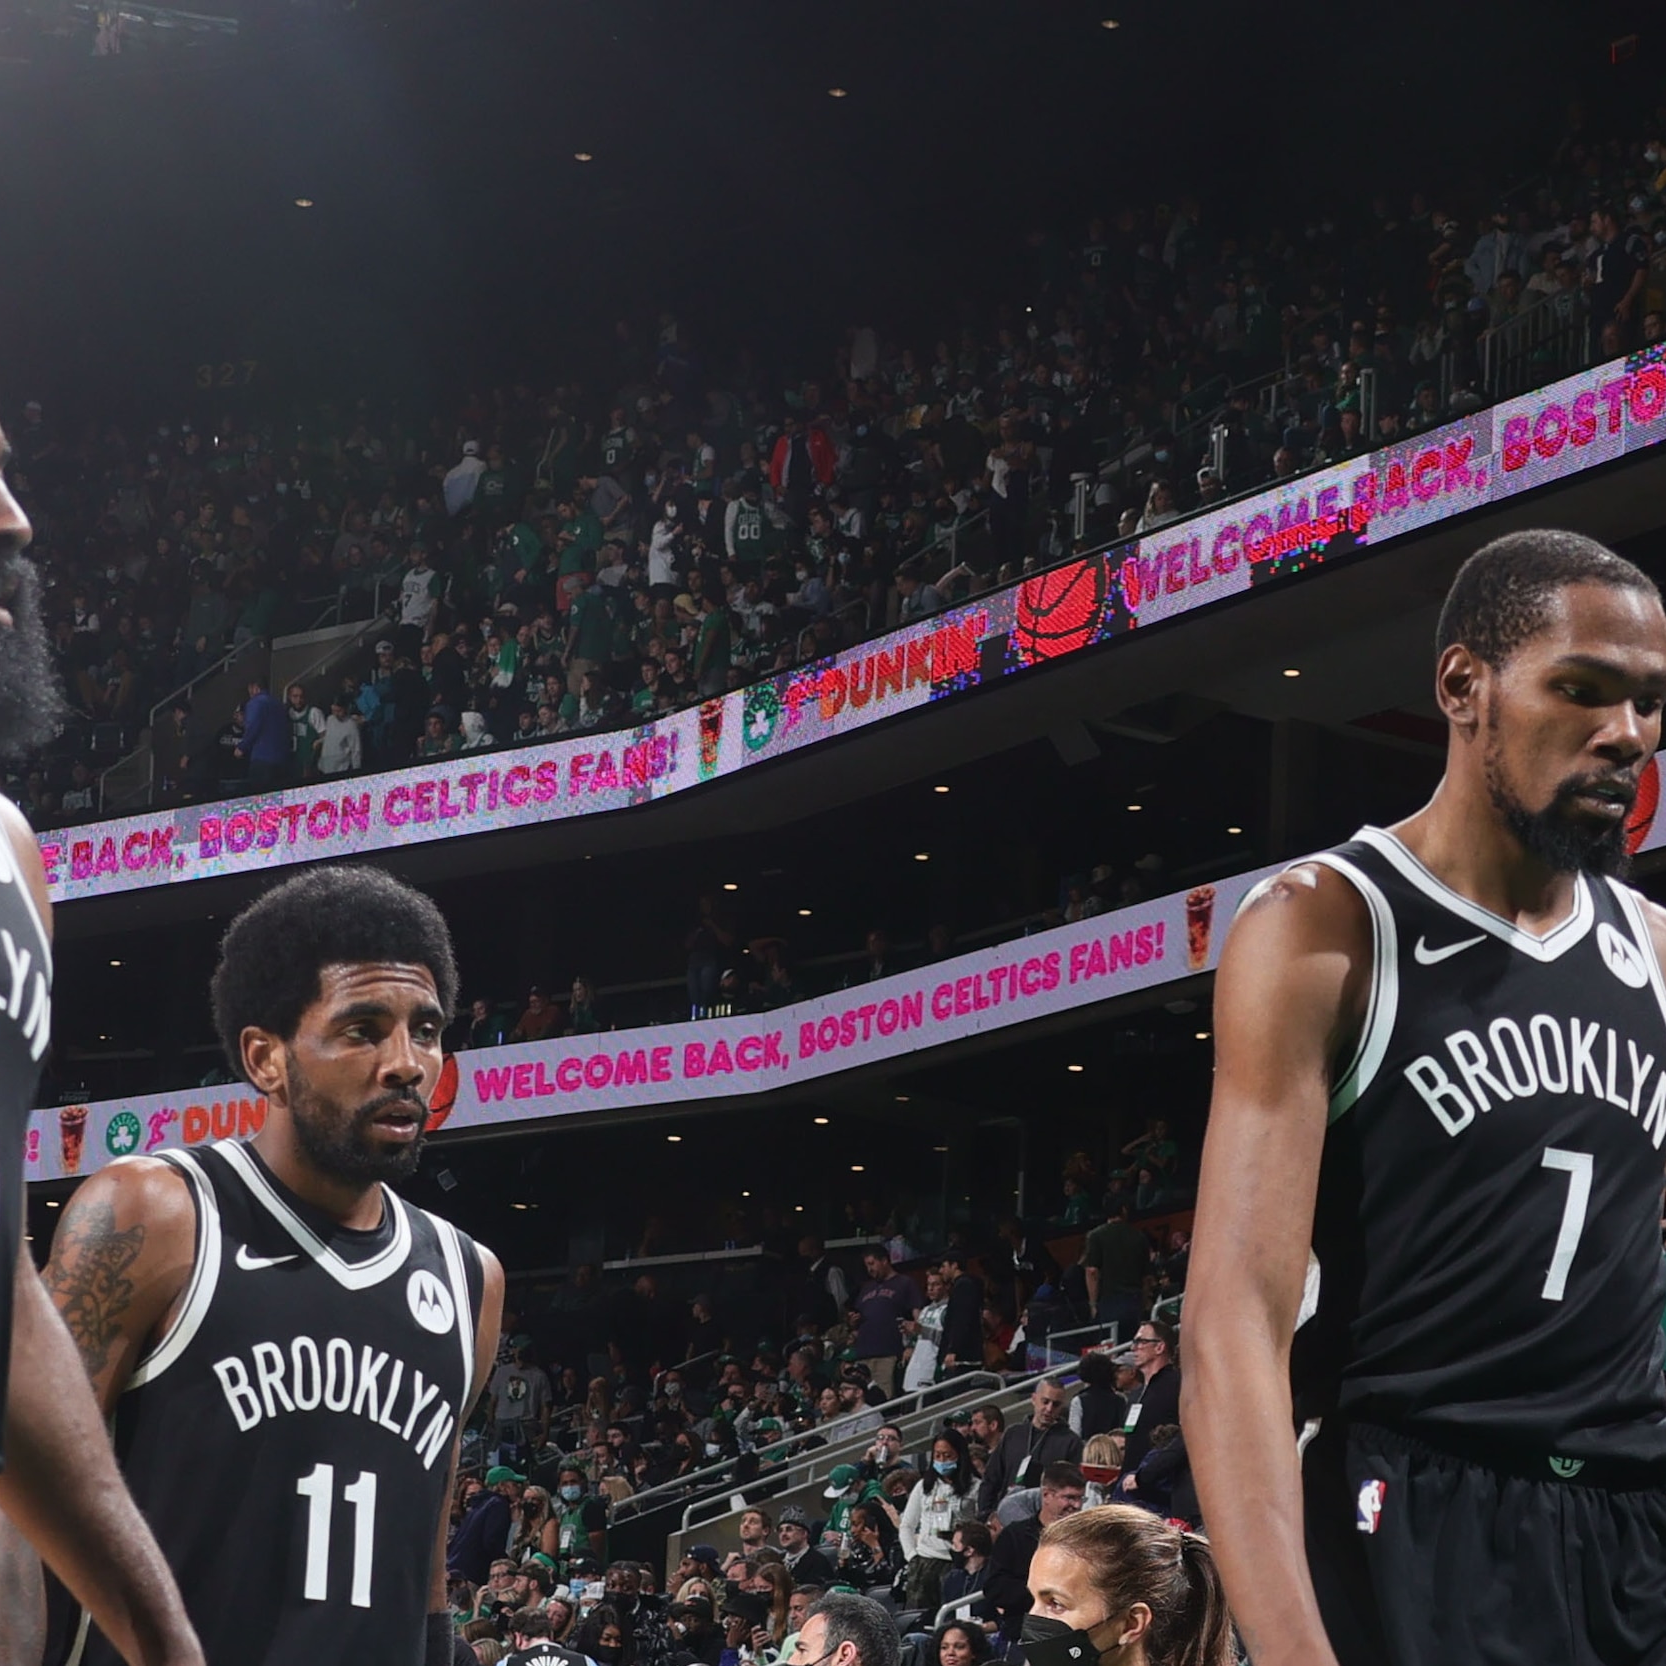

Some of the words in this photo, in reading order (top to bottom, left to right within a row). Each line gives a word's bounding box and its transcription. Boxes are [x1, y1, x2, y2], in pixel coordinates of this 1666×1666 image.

[736, 525, 758, 540] 00
[1124, 484, 1339, 602] WELCOME
[198, 789, 372, 858] BOSTON
[381, 757, 558, 827] CELTICS
[566, 731, 680, 794] FANS!
[474, 1043, 674, 1103] WELCOME
[683, 1031, 789, 1077] BACK,
[797, 992, 924, 1059] BOSTON
[931, 953, 1061, 1022] CELTICS
[1069, 922, 1166, 984] FANS!
[1541, 1147, 1594, 1301] 7
[213, 1336, 454, 1471] BROOKLYN
[297, 1463, 377, 1608] 11
